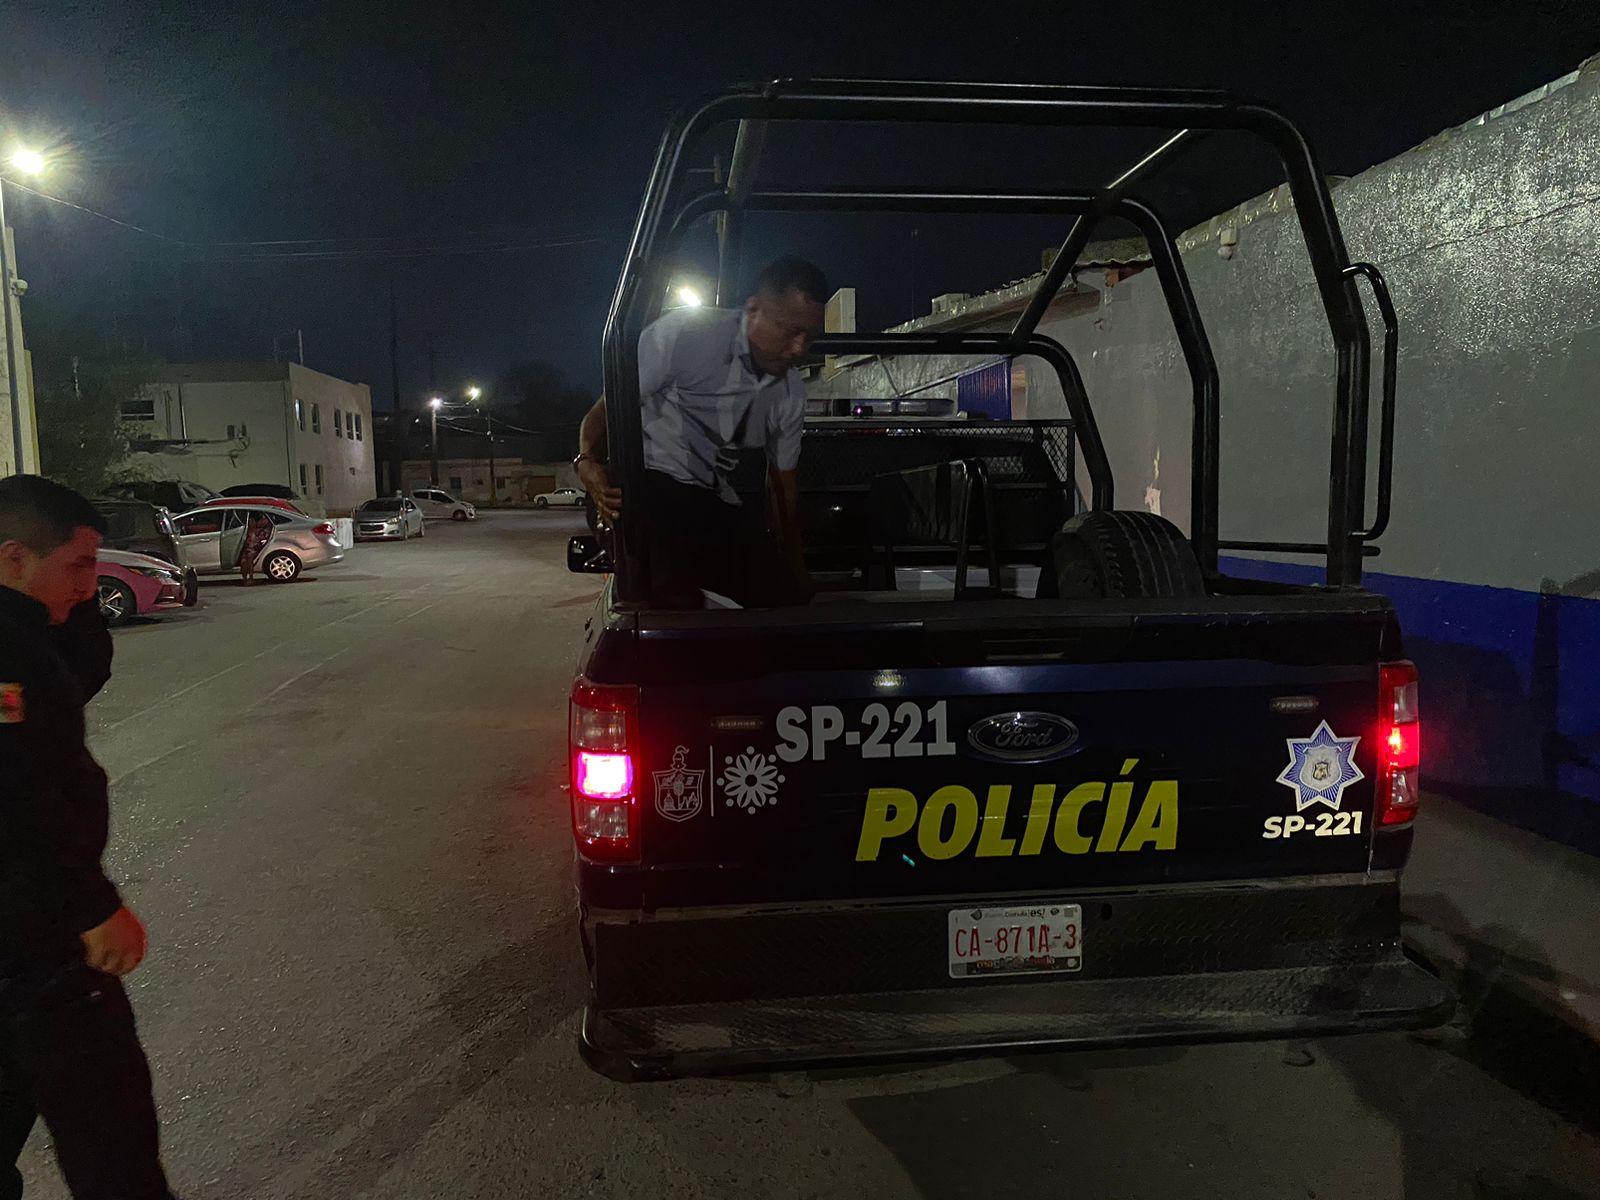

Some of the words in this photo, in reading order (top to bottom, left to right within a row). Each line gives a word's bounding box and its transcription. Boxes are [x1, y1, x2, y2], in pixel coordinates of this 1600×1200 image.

[775, 701, 956, 761] SP-221
[993, 722, 1055, 748] Ford
[855, 759, 1179, 862] POLICÍA
[1263, 811, 1363, 840] SP-221
[955, 923, 1077, 957] CA-871A-3
